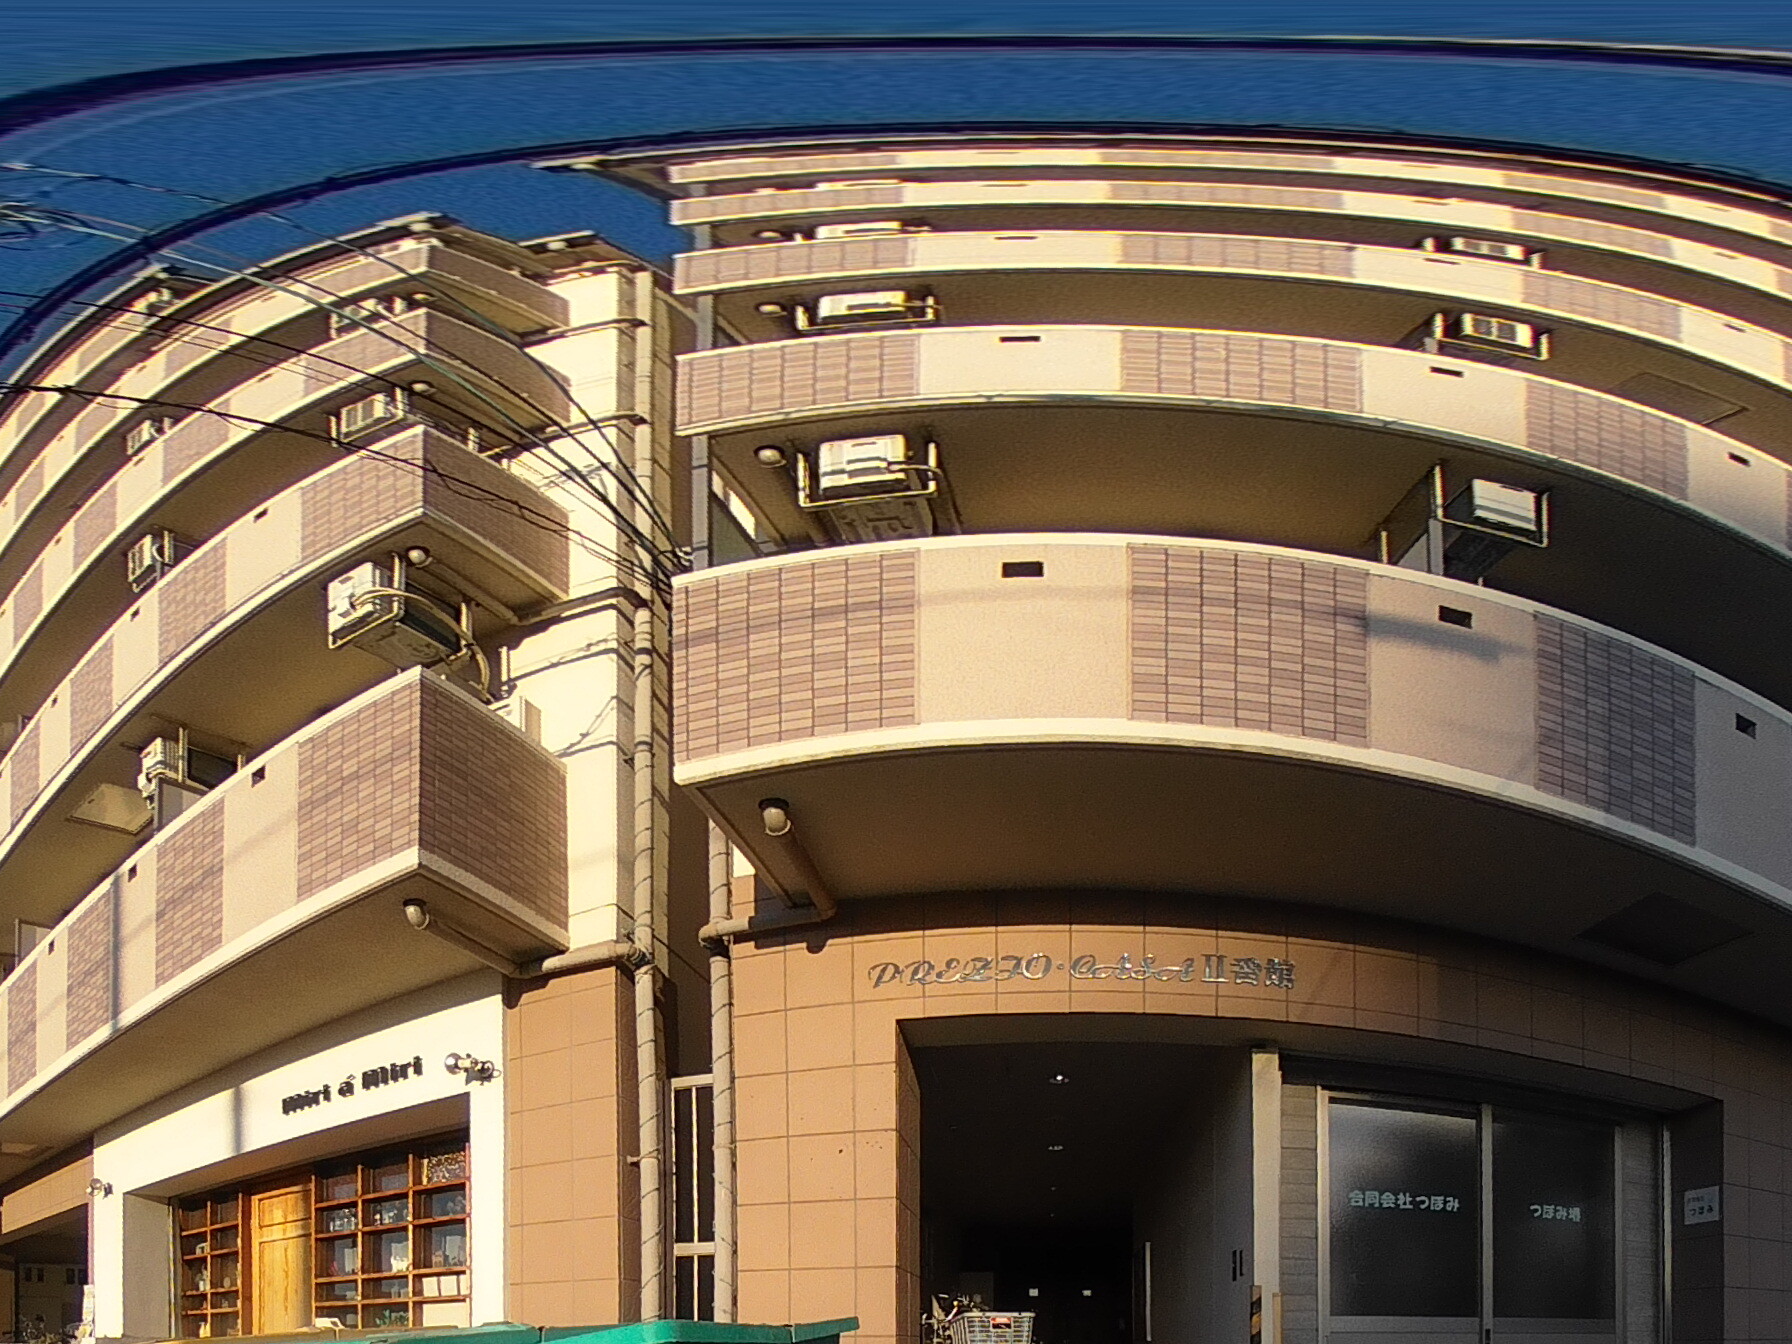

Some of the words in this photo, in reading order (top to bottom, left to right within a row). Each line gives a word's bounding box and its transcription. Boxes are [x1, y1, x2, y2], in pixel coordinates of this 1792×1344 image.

[1348, 1190, 1460, 1212] 合同会社つぼみ
